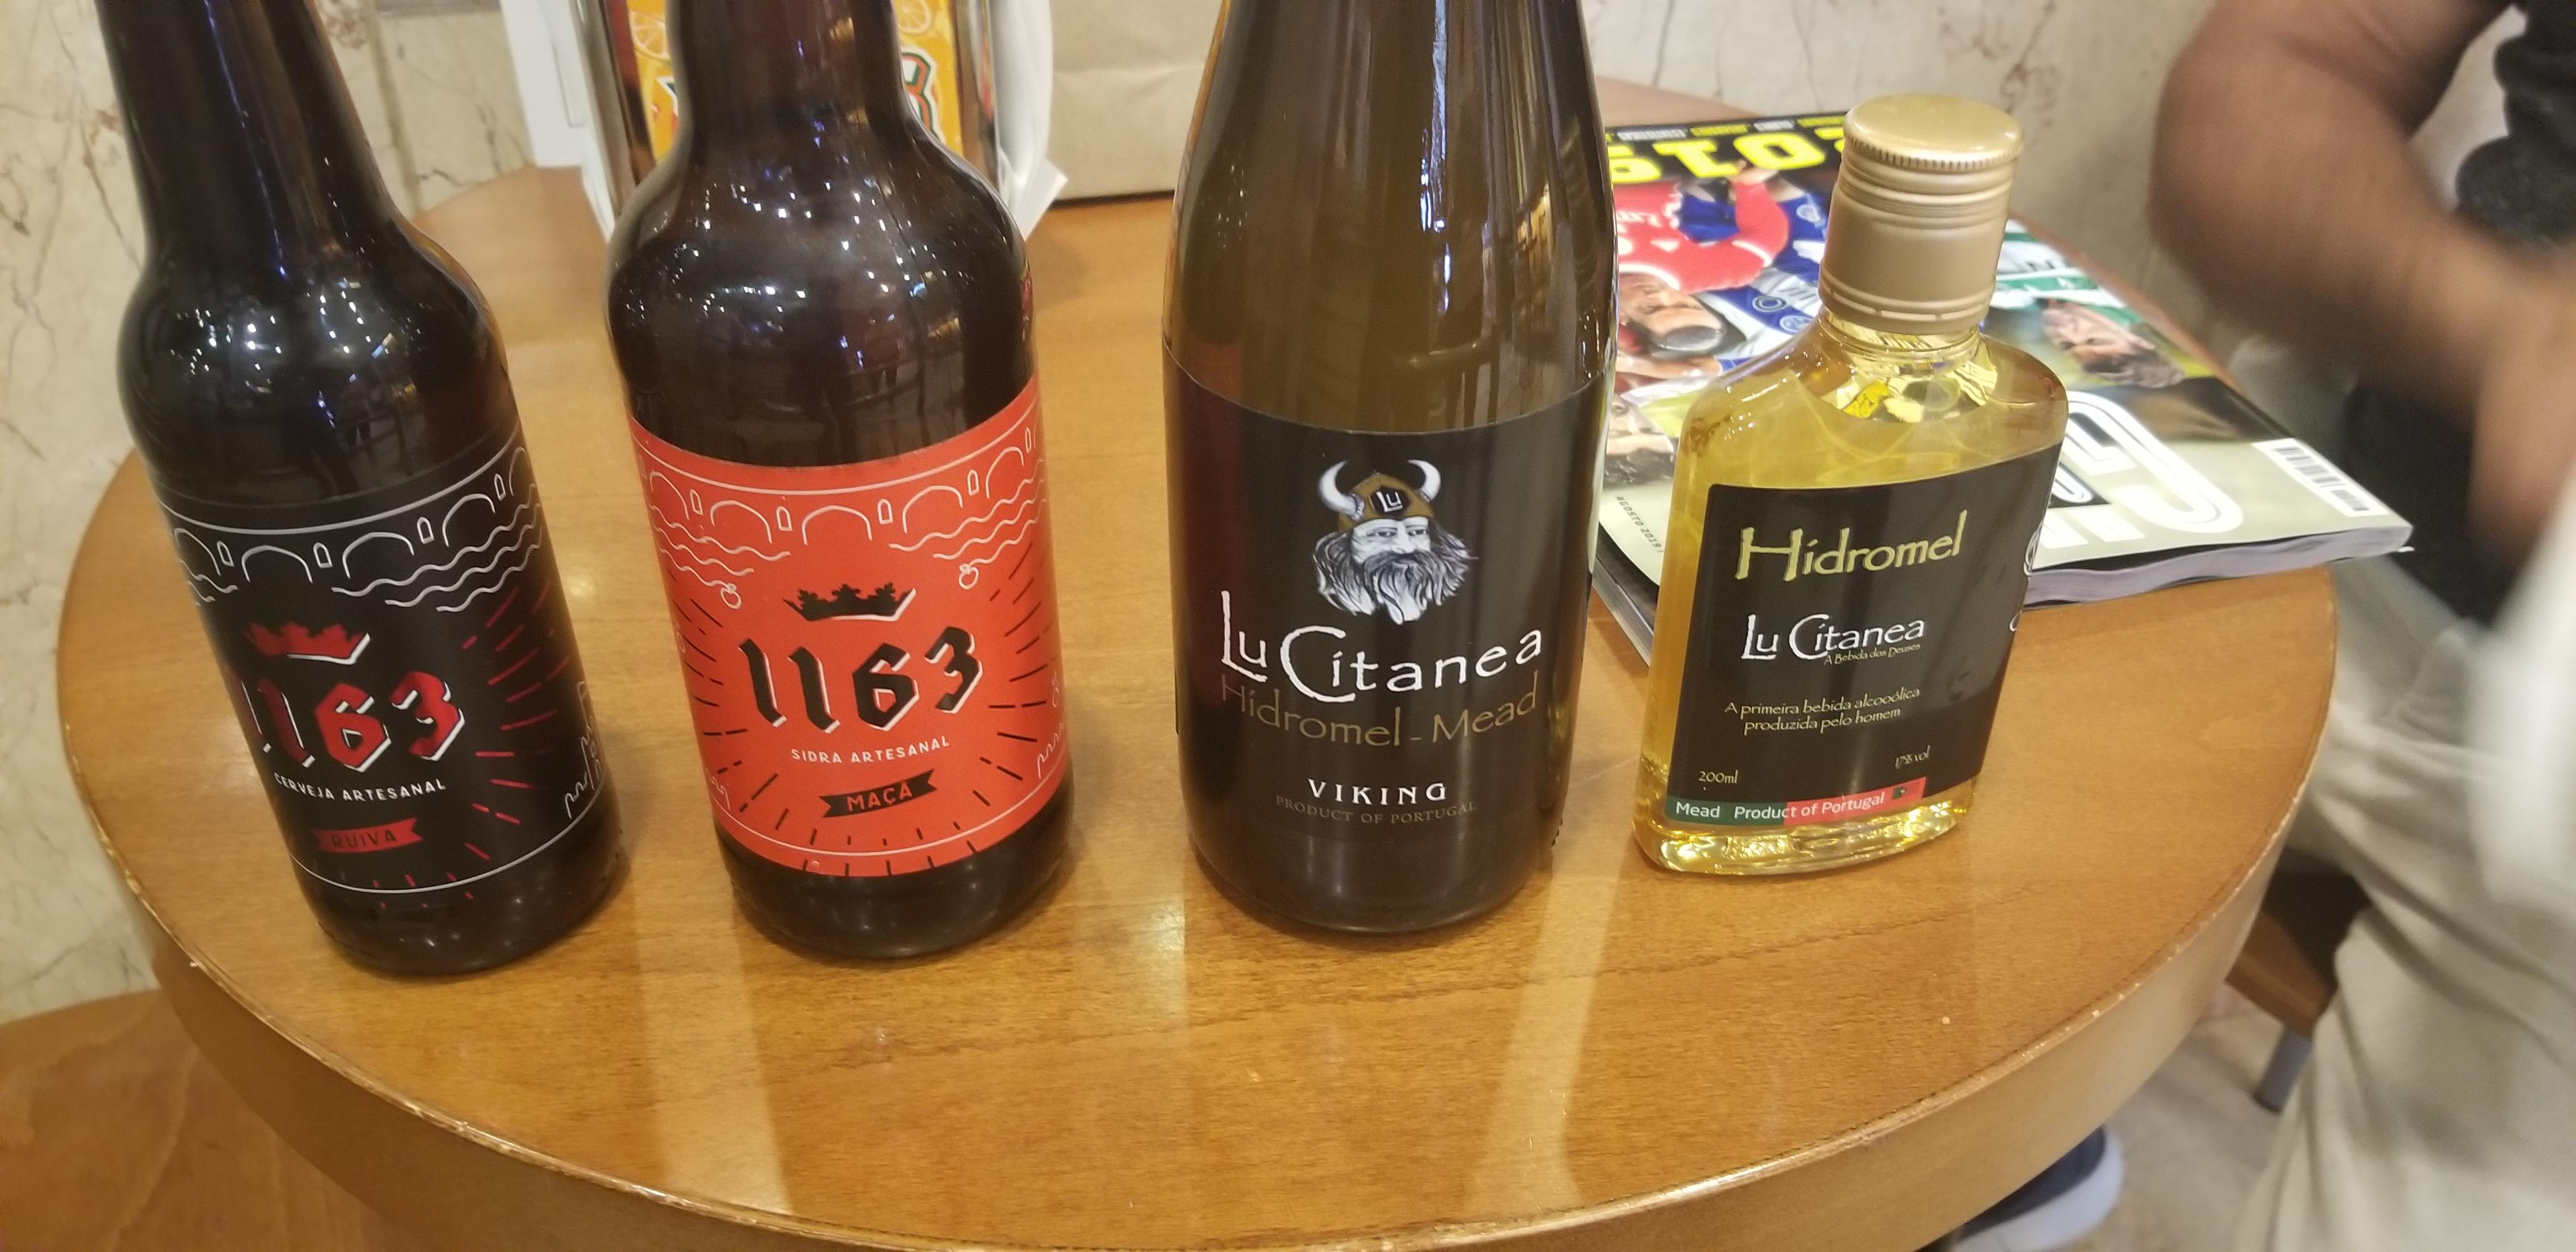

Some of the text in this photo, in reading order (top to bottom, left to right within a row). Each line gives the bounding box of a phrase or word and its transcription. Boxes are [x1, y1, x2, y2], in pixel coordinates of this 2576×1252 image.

[1377, 488, 1403, 512] Lu
[1615, 496, 1662, 547] AGOSTO 2019
[1735, 509, 1968, 582] Hidromel
[1222, 590, 1542, 703] Lu Citanea
[1741, 614, 1925, 660] Lu Citanea
[1823, 655, 1832, 665] A
[1834, 649, 1867, 664] Bebida
[1869, 647, 1886, 658] dos
[737, 625, 983, 734] 1163
[224, 668, 466, 772] 1163
[1221, 675, 1401, 747] Hidromel
[1432, 669, 1538, 743] Mead
[1724, 703, 1738, 714] A
[1740, 703, 1799, 720] primeira
[1802, 696, 1851, 713] bebida
[1744, 708, 1901, 736] produzida pelo homem
[792, 735, 951, 764] SIDRA ARTESANAL
[273, 772, 447, 802] CERVEJA ARTESANAL
[1698, 770, 1738, 784] 200ml
[1308, 778, 1446, 806] VIKING
[1675, 791, 1885, 820] Mead Product of Portugal
[1275, 795, 1477, 825] PRODUCT OF PORTUGAL
[330, 830, 398, 850] RUIVA
